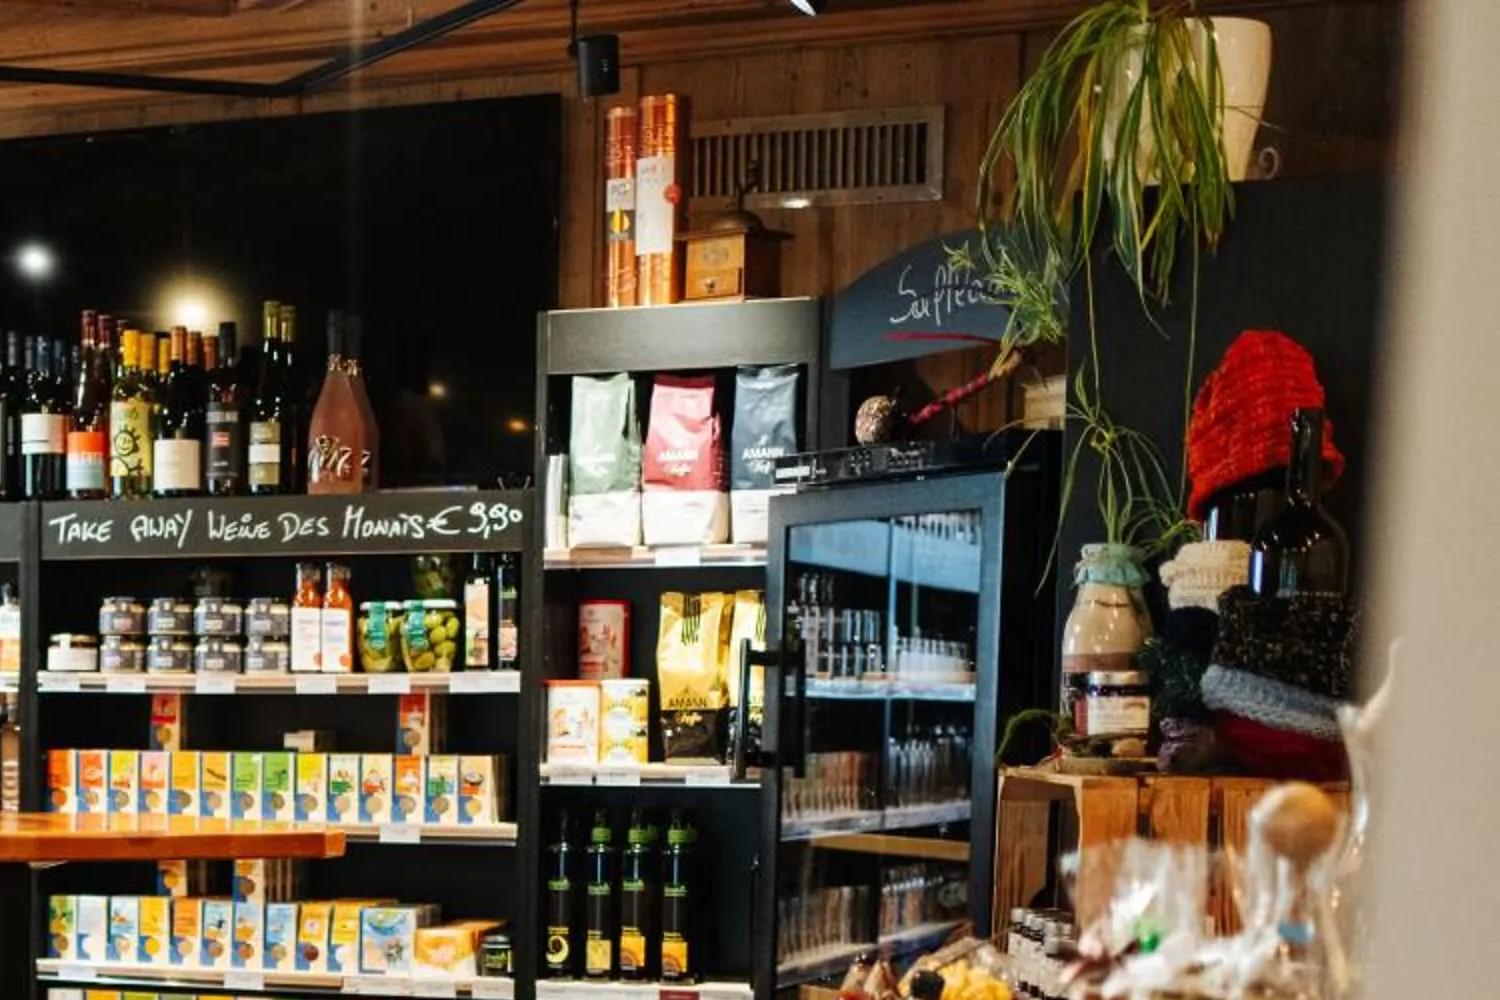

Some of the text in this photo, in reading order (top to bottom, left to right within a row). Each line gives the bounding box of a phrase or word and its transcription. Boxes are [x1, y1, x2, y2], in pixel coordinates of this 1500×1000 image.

[49, 512, 113, 544] TAKE
[130, 508, 193, 549] AWAY
[277, 512, 330, 543] DES
